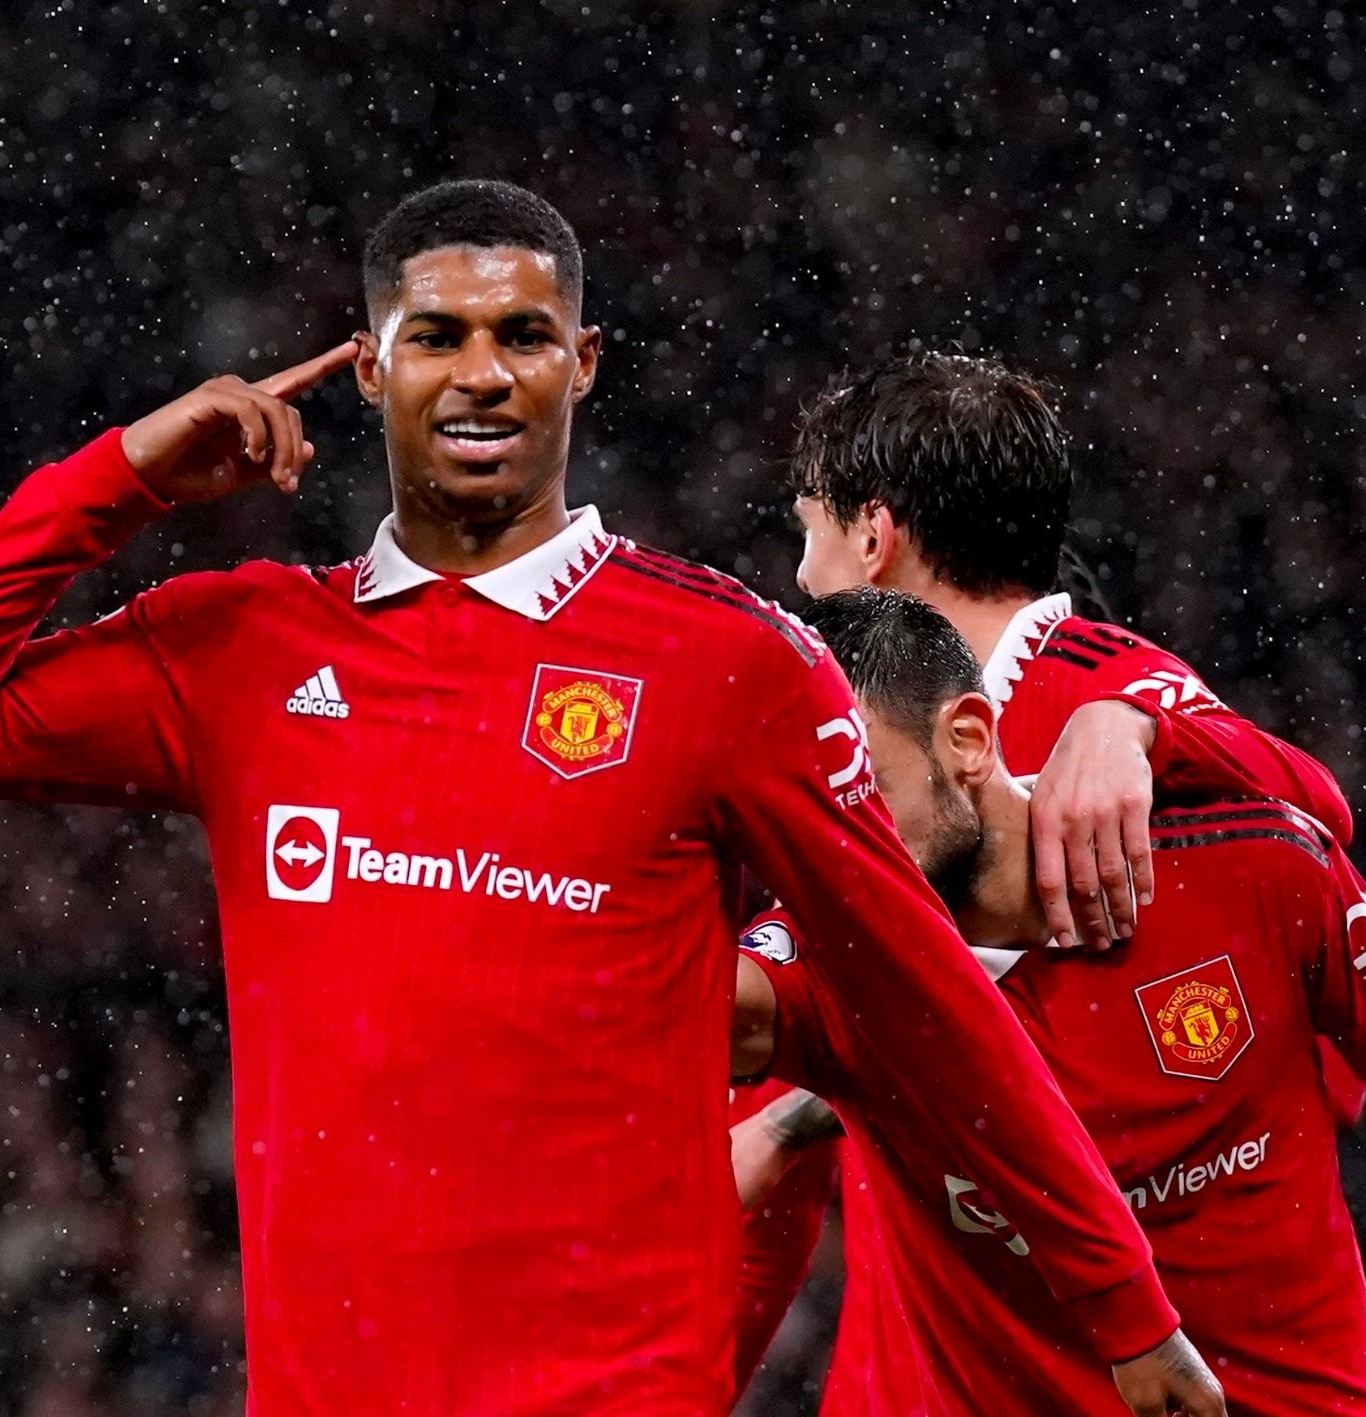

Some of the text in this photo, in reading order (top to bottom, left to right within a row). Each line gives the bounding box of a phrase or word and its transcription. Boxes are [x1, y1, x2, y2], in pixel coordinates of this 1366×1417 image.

[286, 695, 350, 719] adidas
[548, 686, 616, 719] MANCHESTER
[551, 738, 600, 755] UNITED
[341, 835, 611, 914] TeamViewer
[1163, 986, 1226, 1024] MANCHESTER
[1187, 1035, 1230, 1059] UNITED
